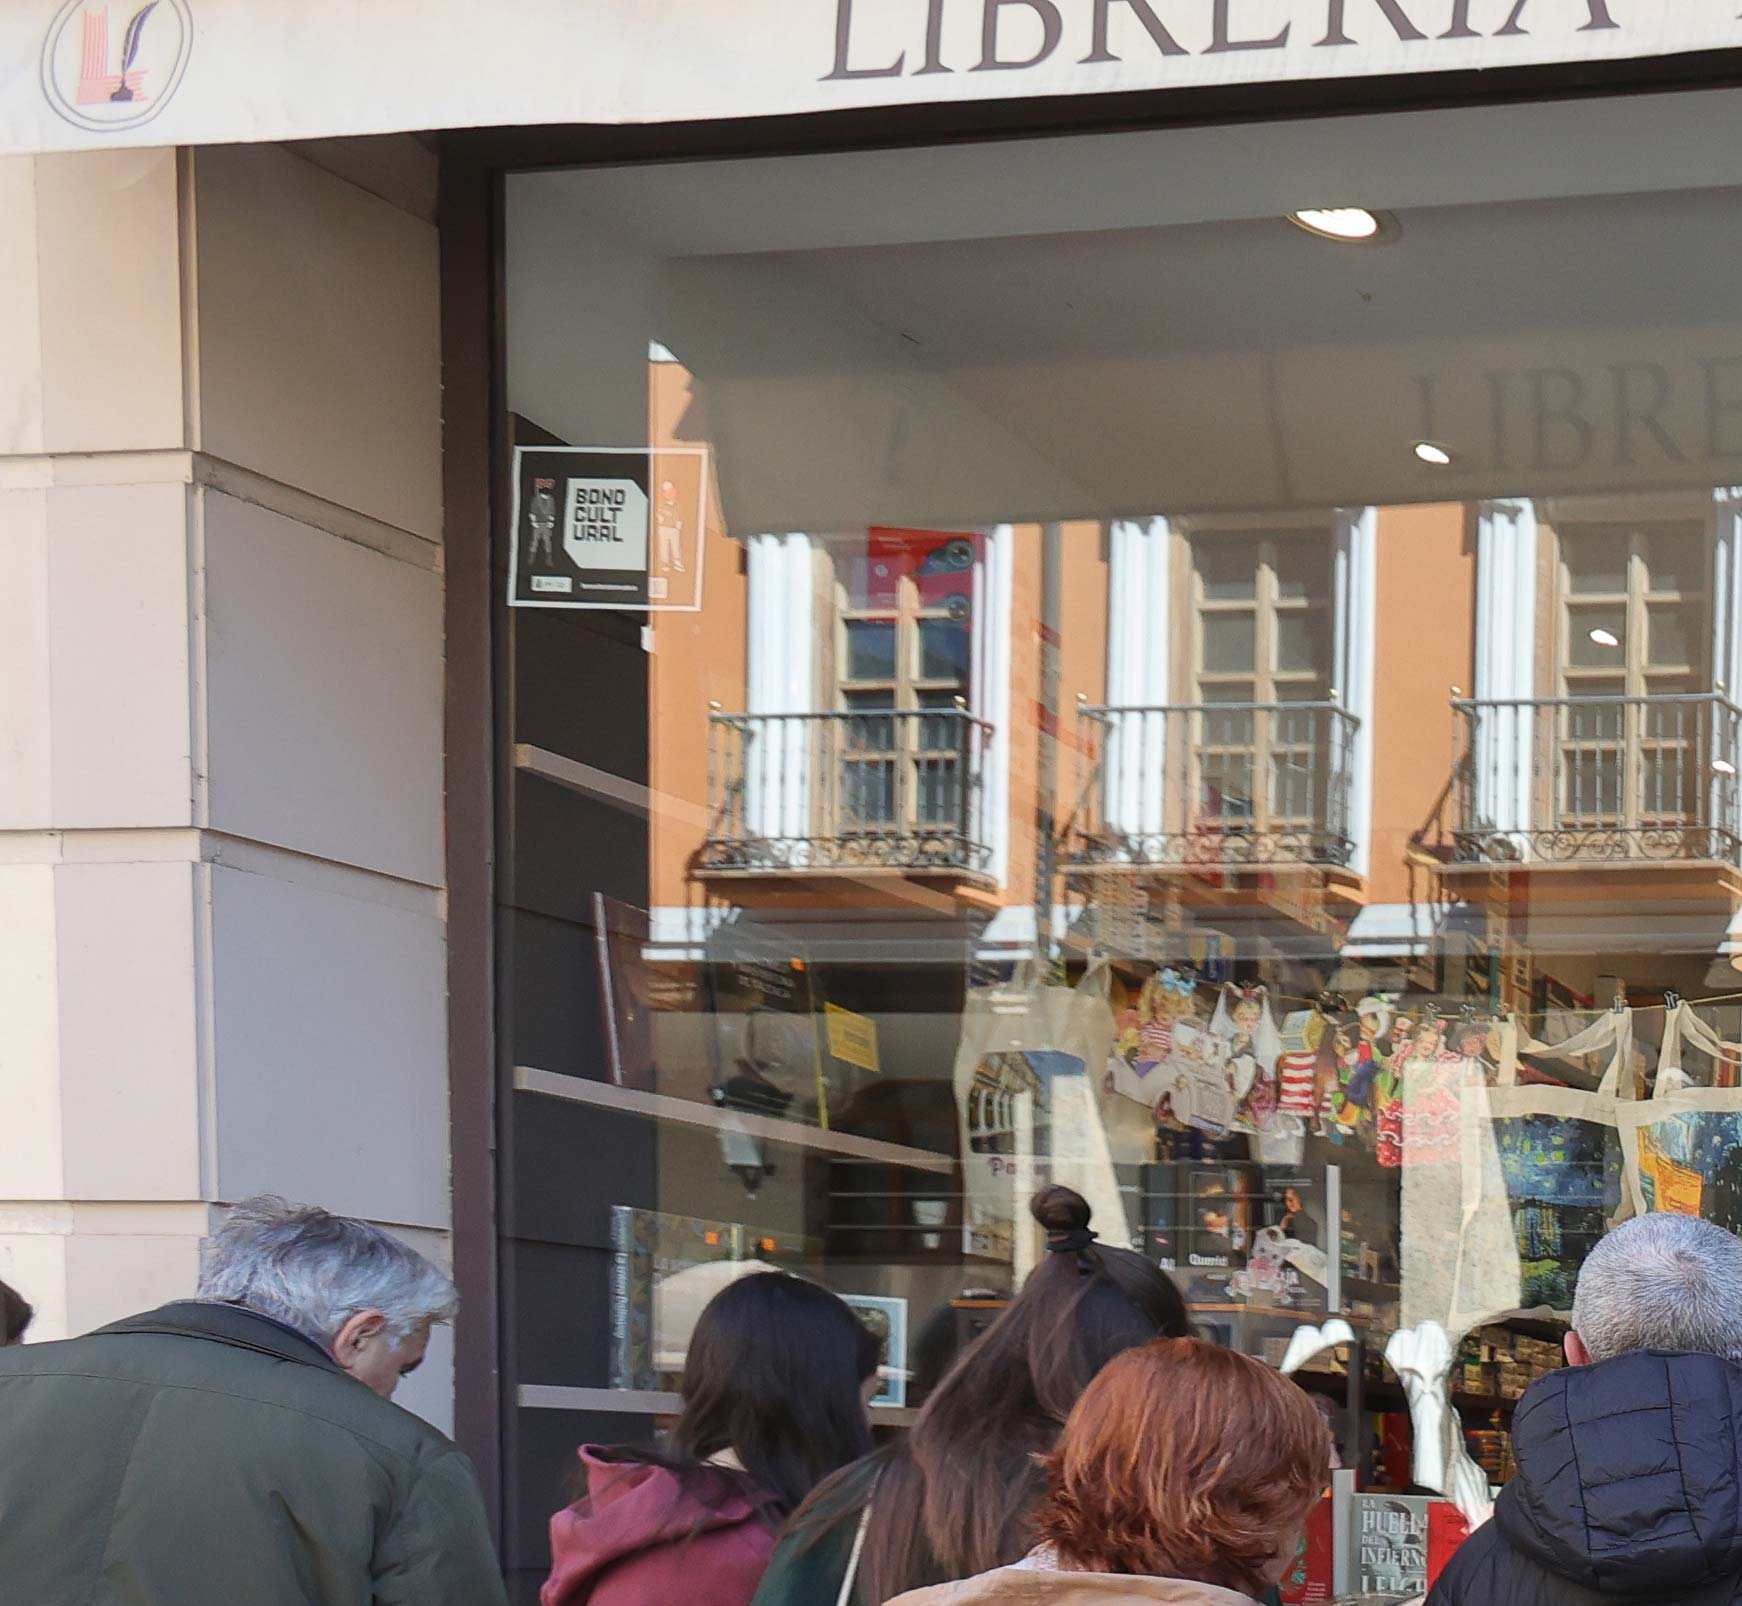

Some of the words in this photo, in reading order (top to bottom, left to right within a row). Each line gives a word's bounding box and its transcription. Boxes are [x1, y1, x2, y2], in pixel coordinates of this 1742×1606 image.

[576, 488, 626, 505] BONO
[575, 507, 623, 524] CULT
[573, 524, 624, 542] URAL
